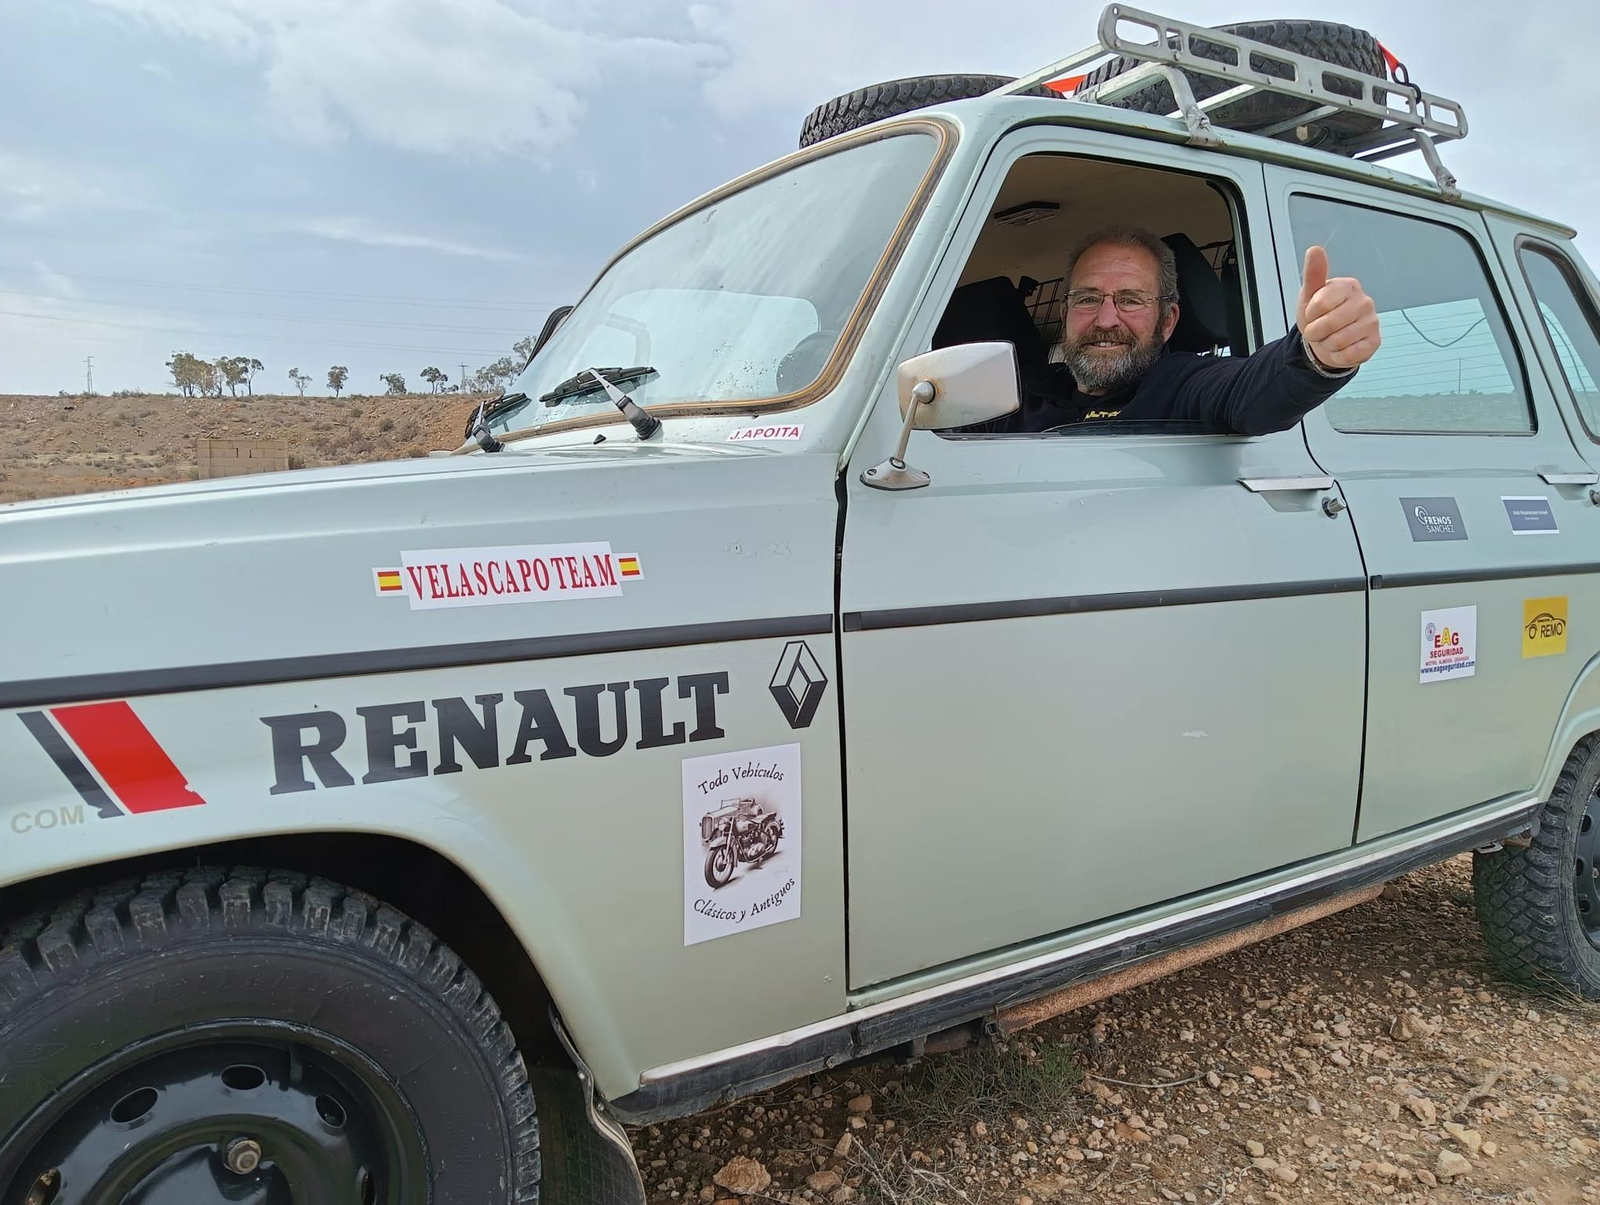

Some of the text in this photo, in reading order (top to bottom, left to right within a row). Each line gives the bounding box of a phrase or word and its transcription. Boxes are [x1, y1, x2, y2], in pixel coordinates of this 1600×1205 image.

[1423, 516, 1452, 525] FRENOS
[1426, 524, 1455, 534] SANCHEZ
[1434, 627, 1459, 648] EAG
[1540, 622, 1563, 638] REMO
[1429, 647, 1464, 658] SEGURIDAD
[1420, 661, 1475, 674] www.eagseguridad.com
[259, 671, 729, 795] RENAULT
[698, 762, 785, 795] Todo Vehículos
[693, 877, 796, 924] Clásicos y Antiguos
